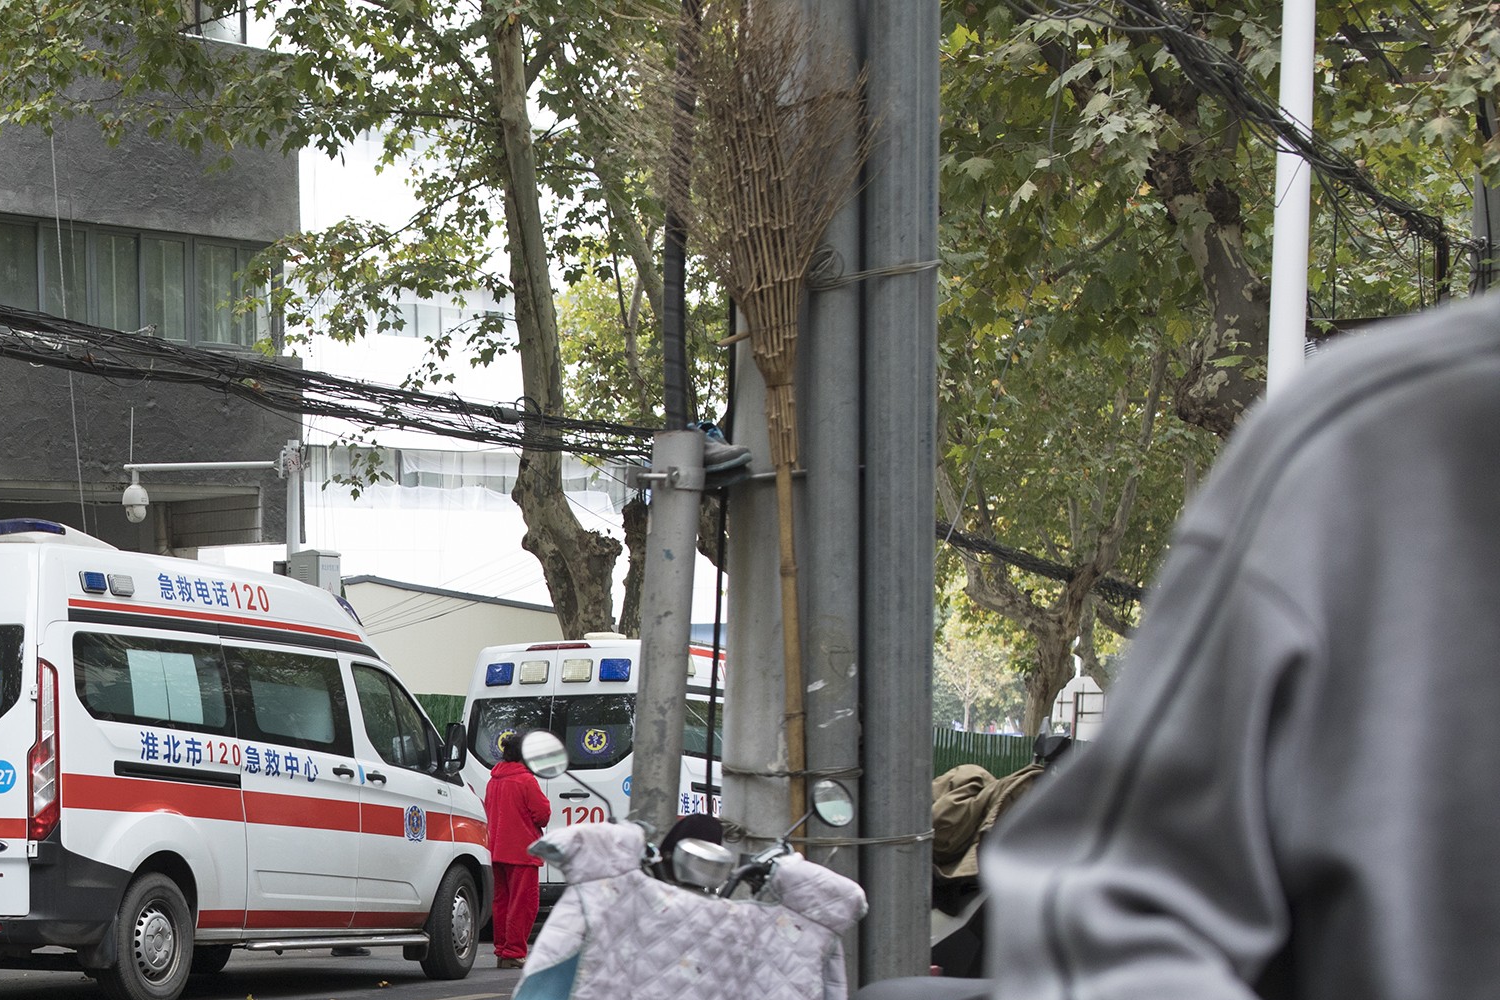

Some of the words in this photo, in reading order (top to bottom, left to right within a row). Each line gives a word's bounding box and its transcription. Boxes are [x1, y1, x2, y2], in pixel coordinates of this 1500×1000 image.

[157, 573, 270, 613] 急救电话120
[140, 731, 319, 783] 淮北市120急救中心
[562, 806, 605, 827] 120
